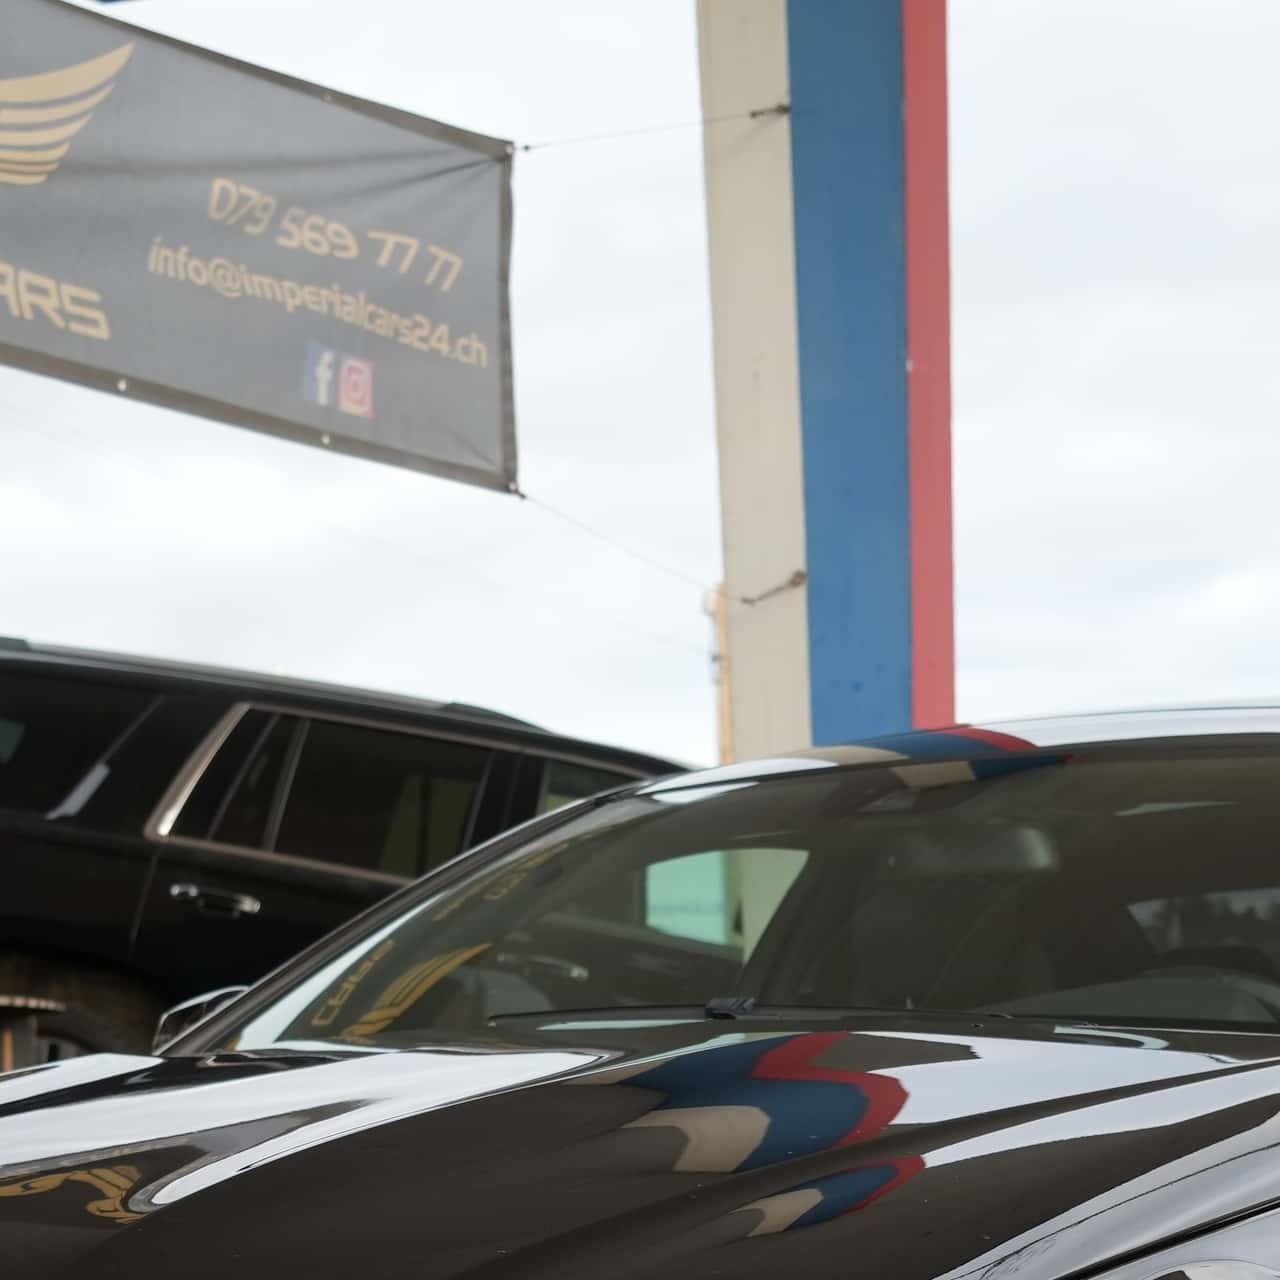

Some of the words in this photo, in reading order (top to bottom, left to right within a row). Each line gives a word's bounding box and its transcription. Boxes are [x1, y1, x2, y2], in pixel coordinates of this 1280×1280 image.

[147, 235, 489, 369] info@imperialcars24.ch
[275, 207, 359, 259] 569
[368, 229, 419, 274] 77
[424, 244, 464, 292] 77
